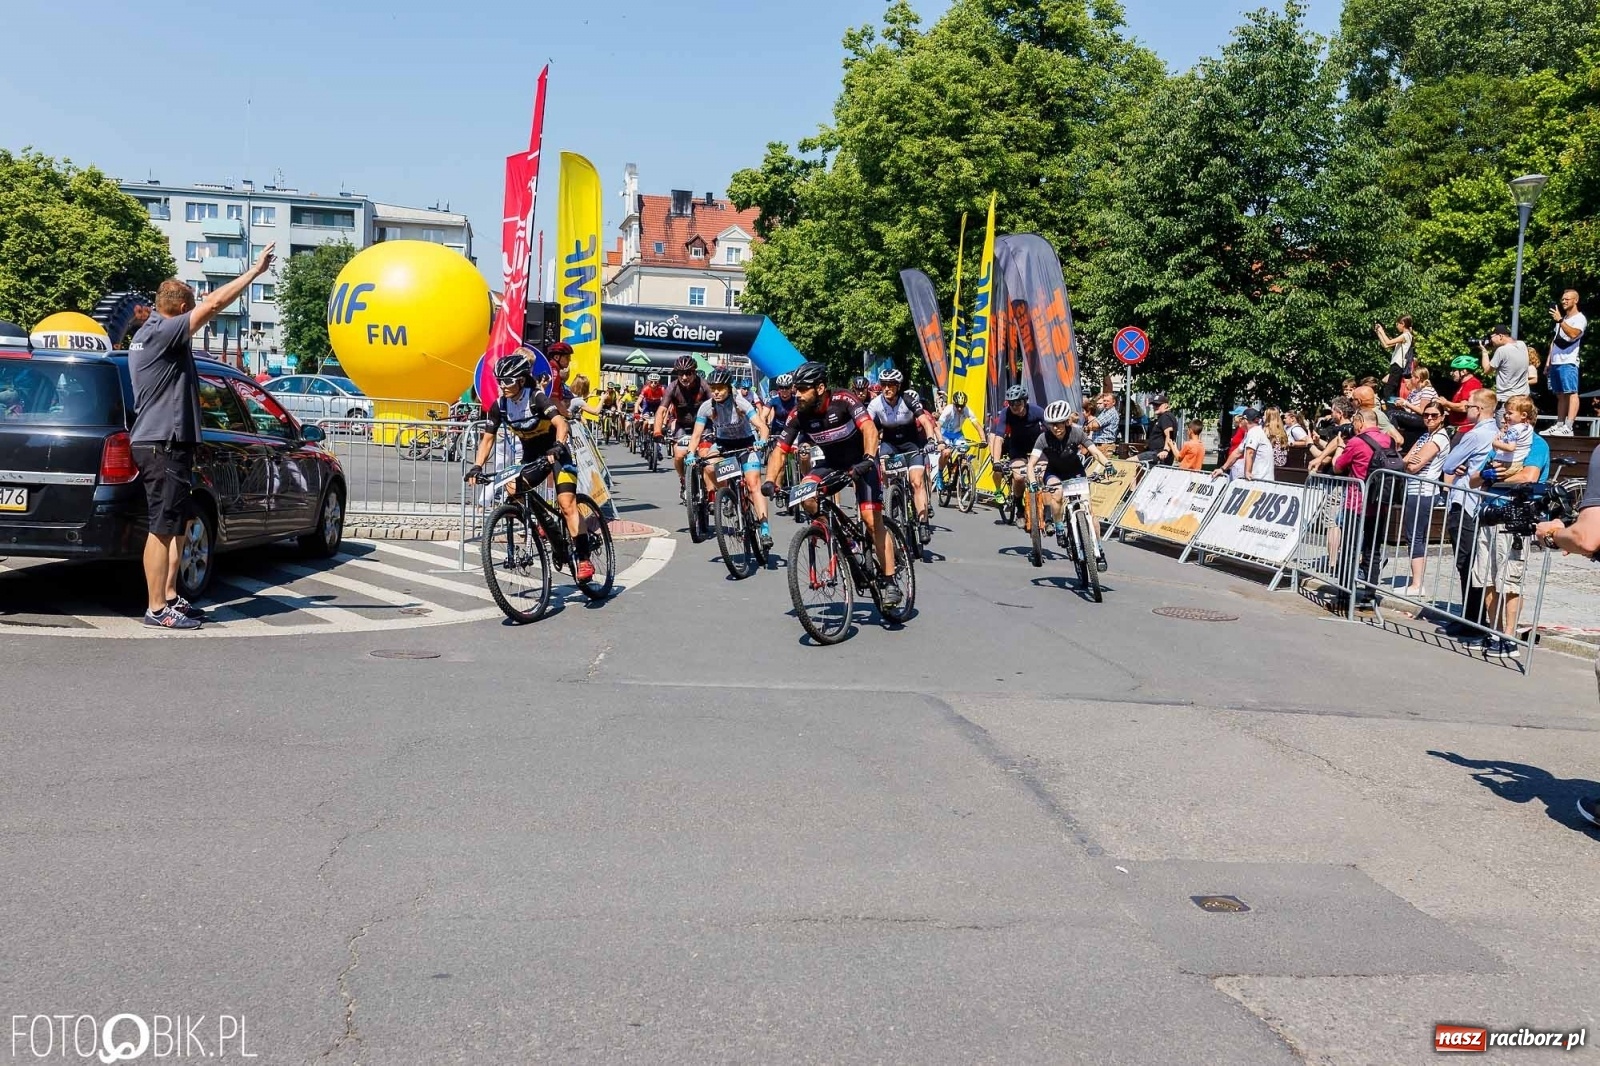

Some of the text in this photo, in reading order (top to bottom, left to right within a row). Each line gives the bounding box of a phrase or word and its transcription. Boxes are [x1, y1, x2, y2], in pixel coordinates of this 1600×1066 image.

[367, 324, 408, 346] FM
[634, 320, 723, 342] bike atelier
[43, 334, 94, 349] TAURUS
[602, 363, 675, 374] MERIDA
[718, 463, 736, 474] 1009
[1186, 481, 1209, 496] TAURUS
[1221, 487, 1289, 524] TAURUS
